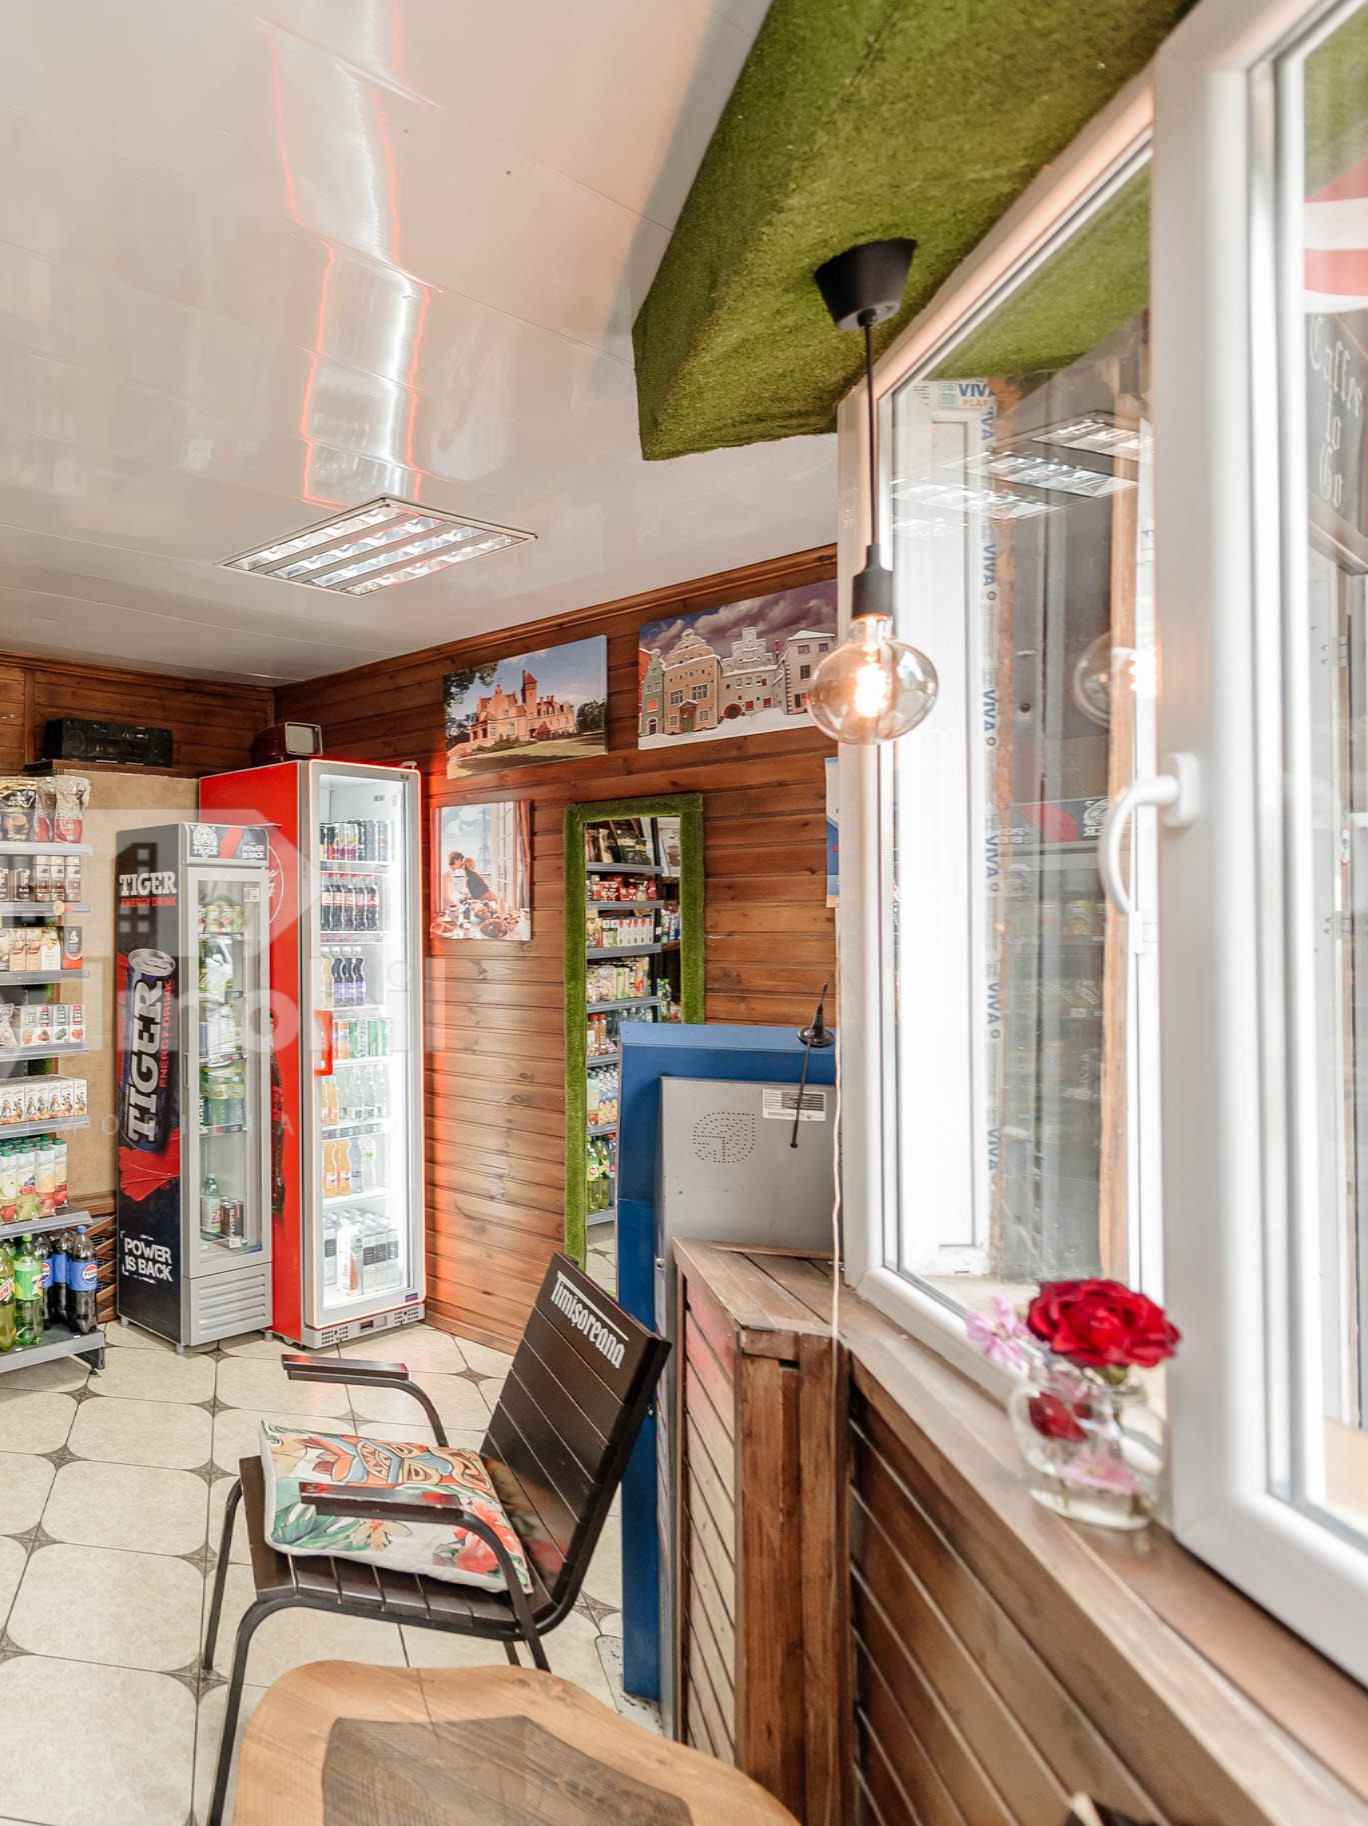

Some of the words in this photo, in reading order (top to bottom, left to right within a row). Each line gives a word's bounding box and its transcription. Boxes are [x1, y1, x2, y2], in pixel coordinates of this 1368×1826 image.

[983, 544, 996, 586] VIVA
[983, 689, 996, 732] VIVA
[119, 871, 177, 896] TIGER
[121, 897, 151, 908] ENERGY
[151, 896, 177, 907] DRINK
[162, 980, 174, 1027] DRINK
[986, 982, 1001, 1025] VIVA
[127, 980, 163, 1143] TIGER
[158, 1032, 171, 1088] ENERGY
[987, 1128, 999, 1170] VIVA
[124, 1237, 172, 1264] POWER
[125, 1255, 136, 1271] IS
[137, 1258, 173, 1282] BACK
